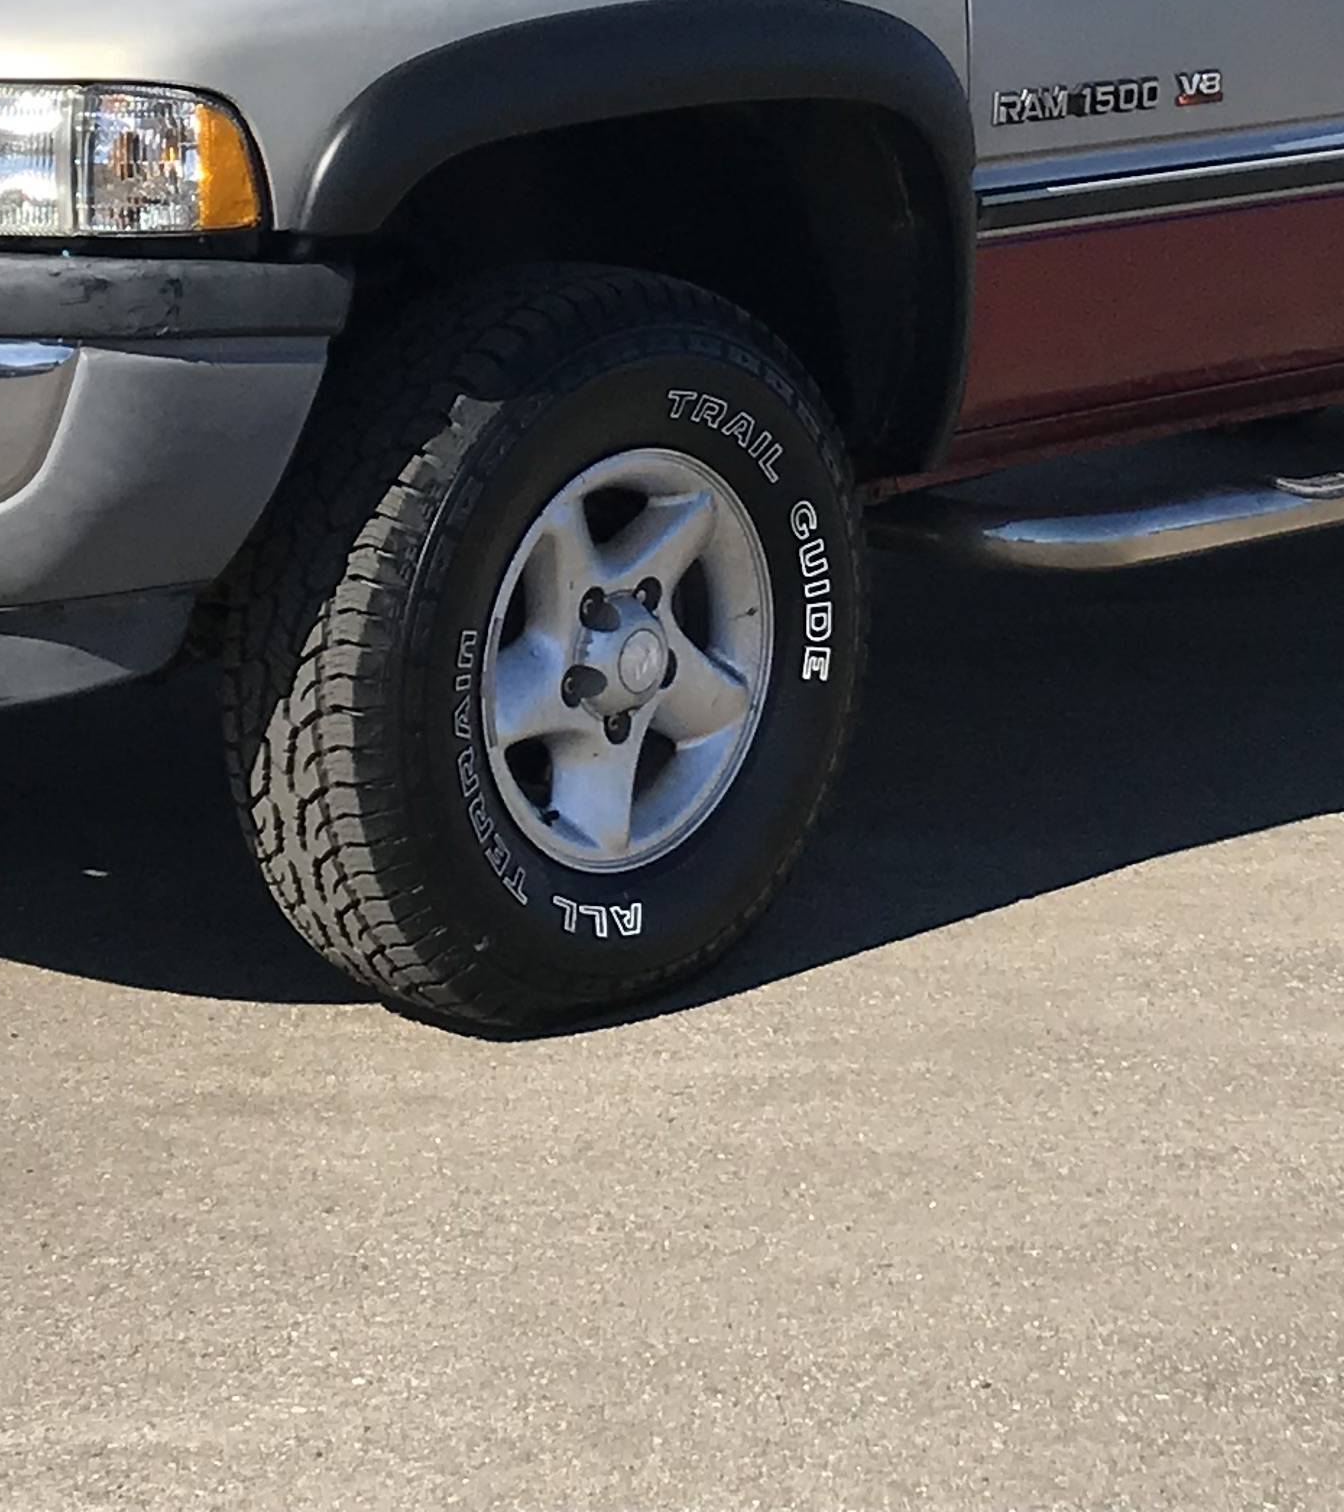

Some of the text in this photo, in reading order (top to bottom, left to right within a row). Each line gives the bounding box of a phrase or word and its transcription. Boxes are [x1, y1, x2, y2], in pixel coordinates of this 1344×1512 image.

[992, 69, 1223, 126] RAM 1500 V8
[668, 389, 832, 682] TRAIL GUIDE
[454, 630, 644, 938] ALL TERRAIN
